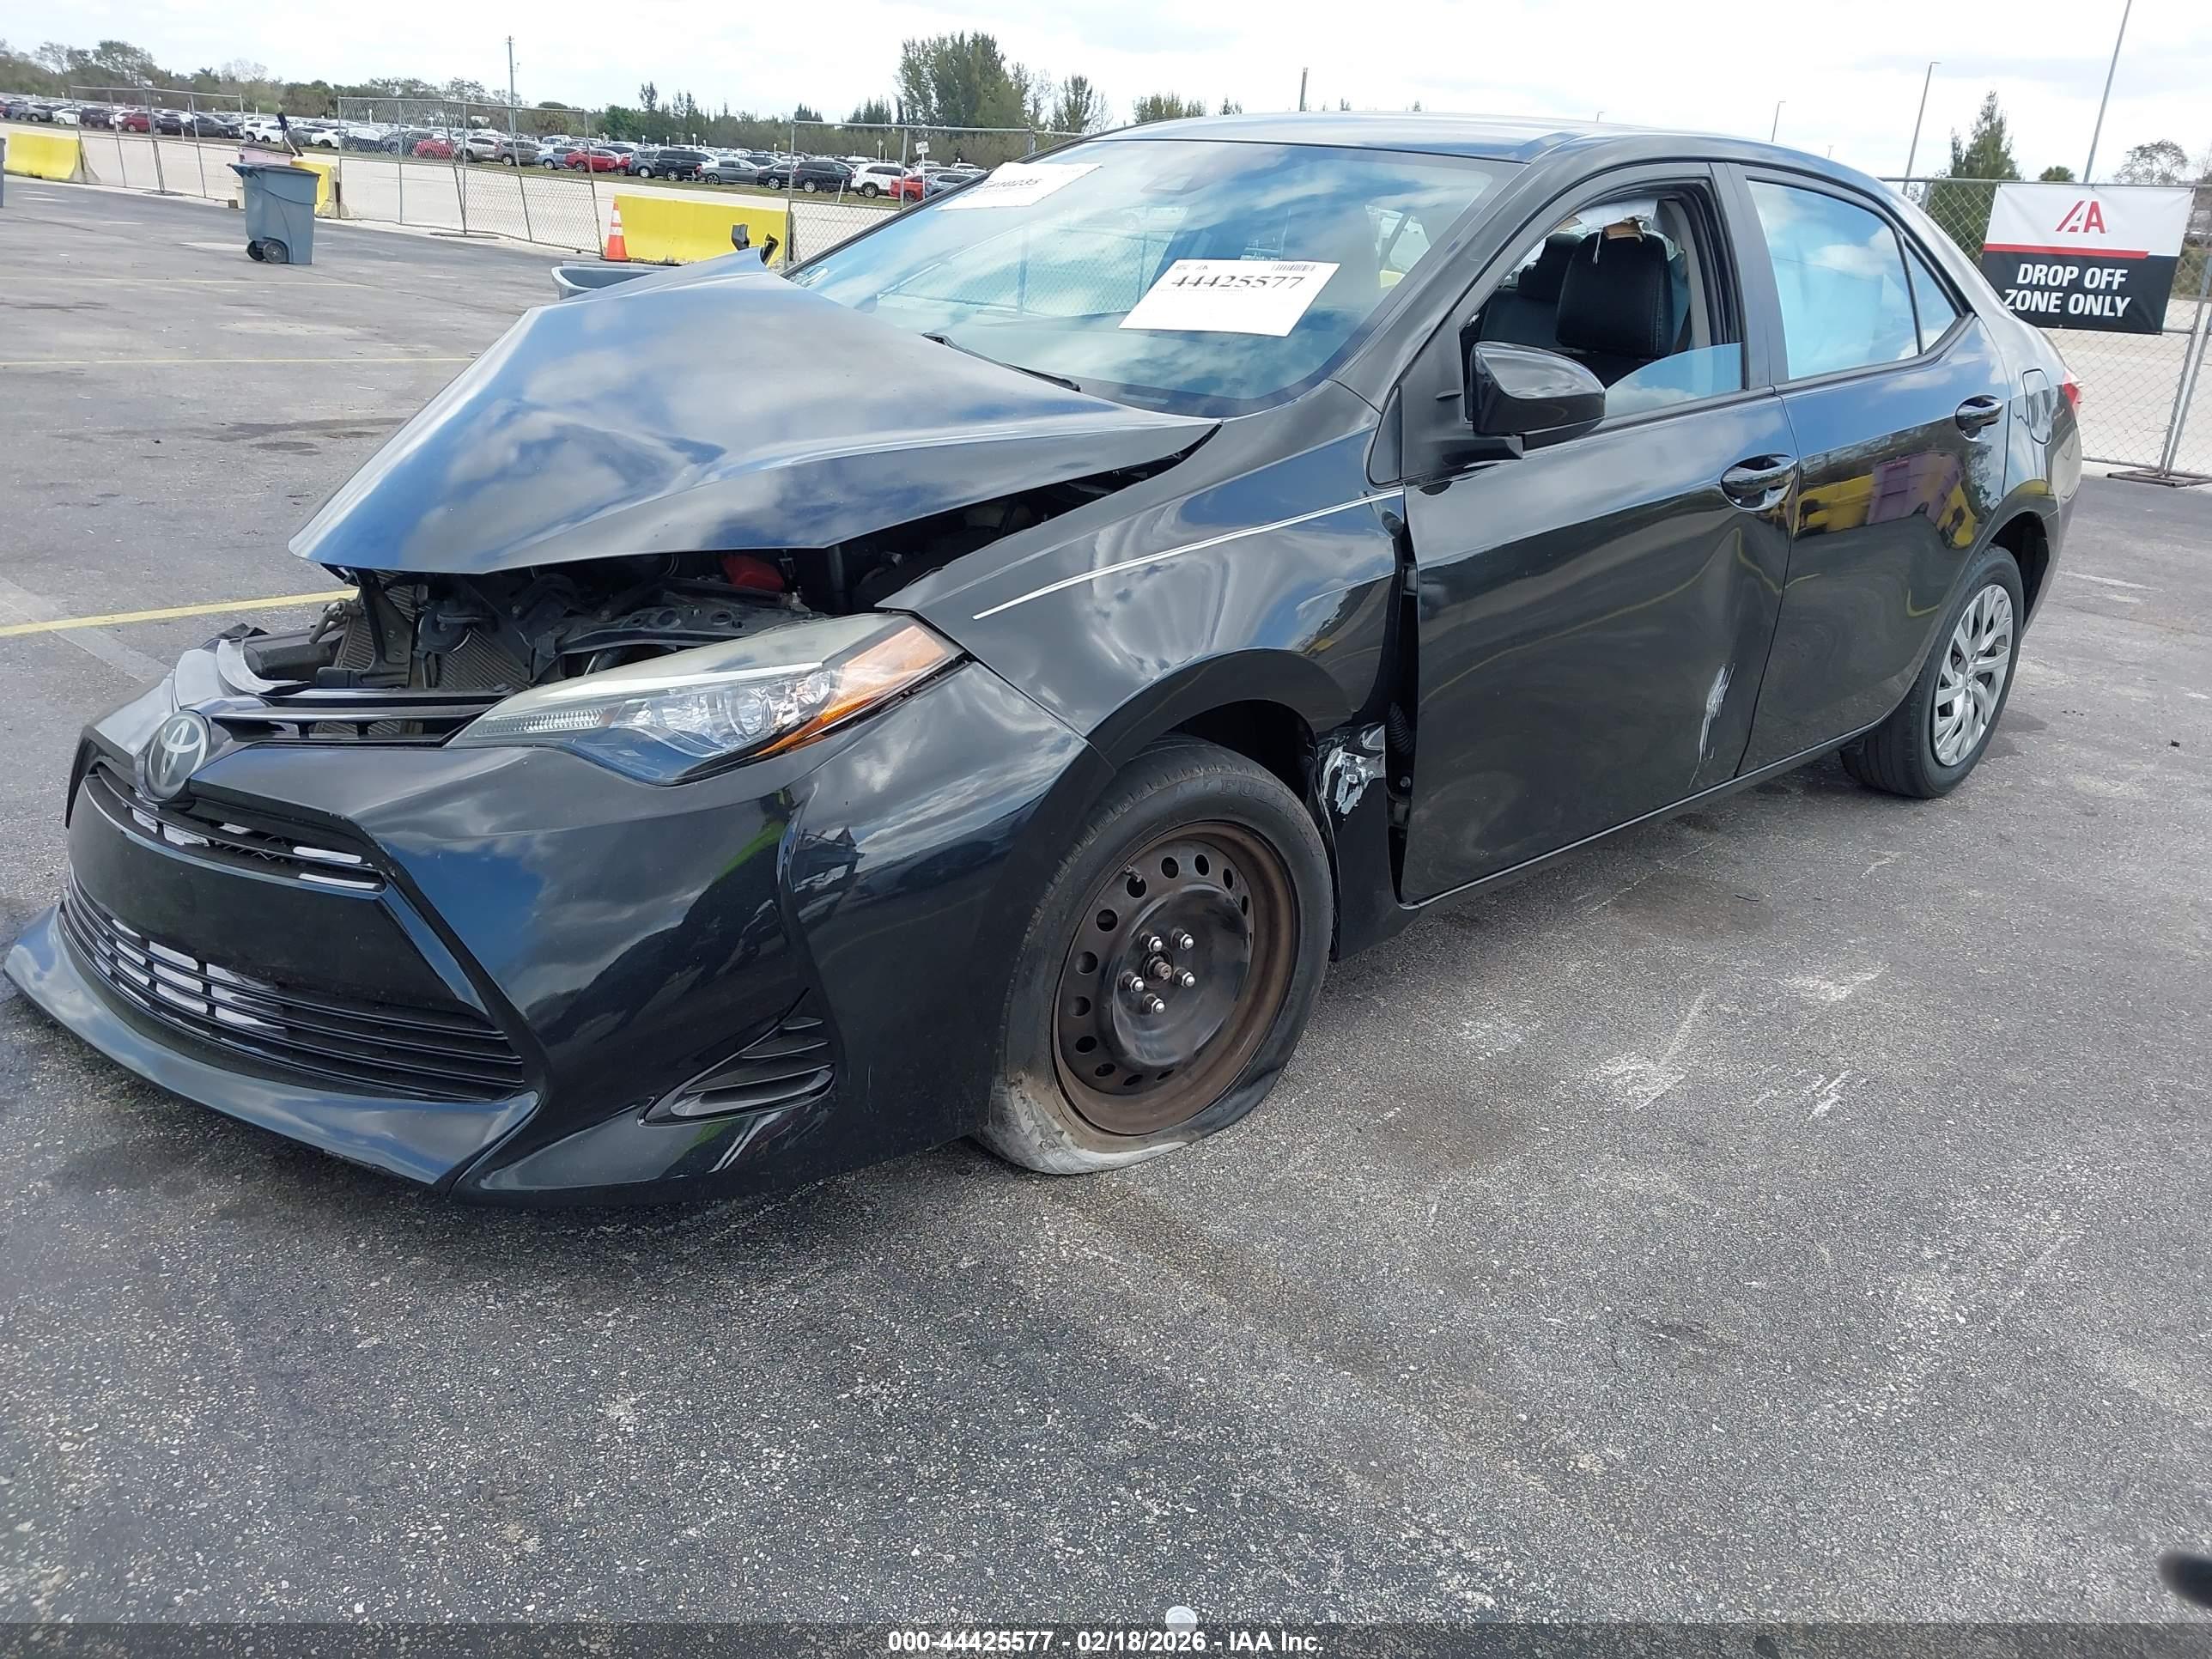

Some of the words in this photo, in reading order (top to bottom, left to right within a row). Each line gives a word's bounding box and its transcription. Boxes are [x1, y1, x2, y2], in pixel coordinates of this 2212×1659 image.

[1171, 275, 1305, 289] 44425577
[2016, 263, 2079, 288] DROP
[2083, 267, 2129, 290] OFF
[2003, 289, 2063, 313] ZONE
[2068, 293, 2132, 318] ONLY
